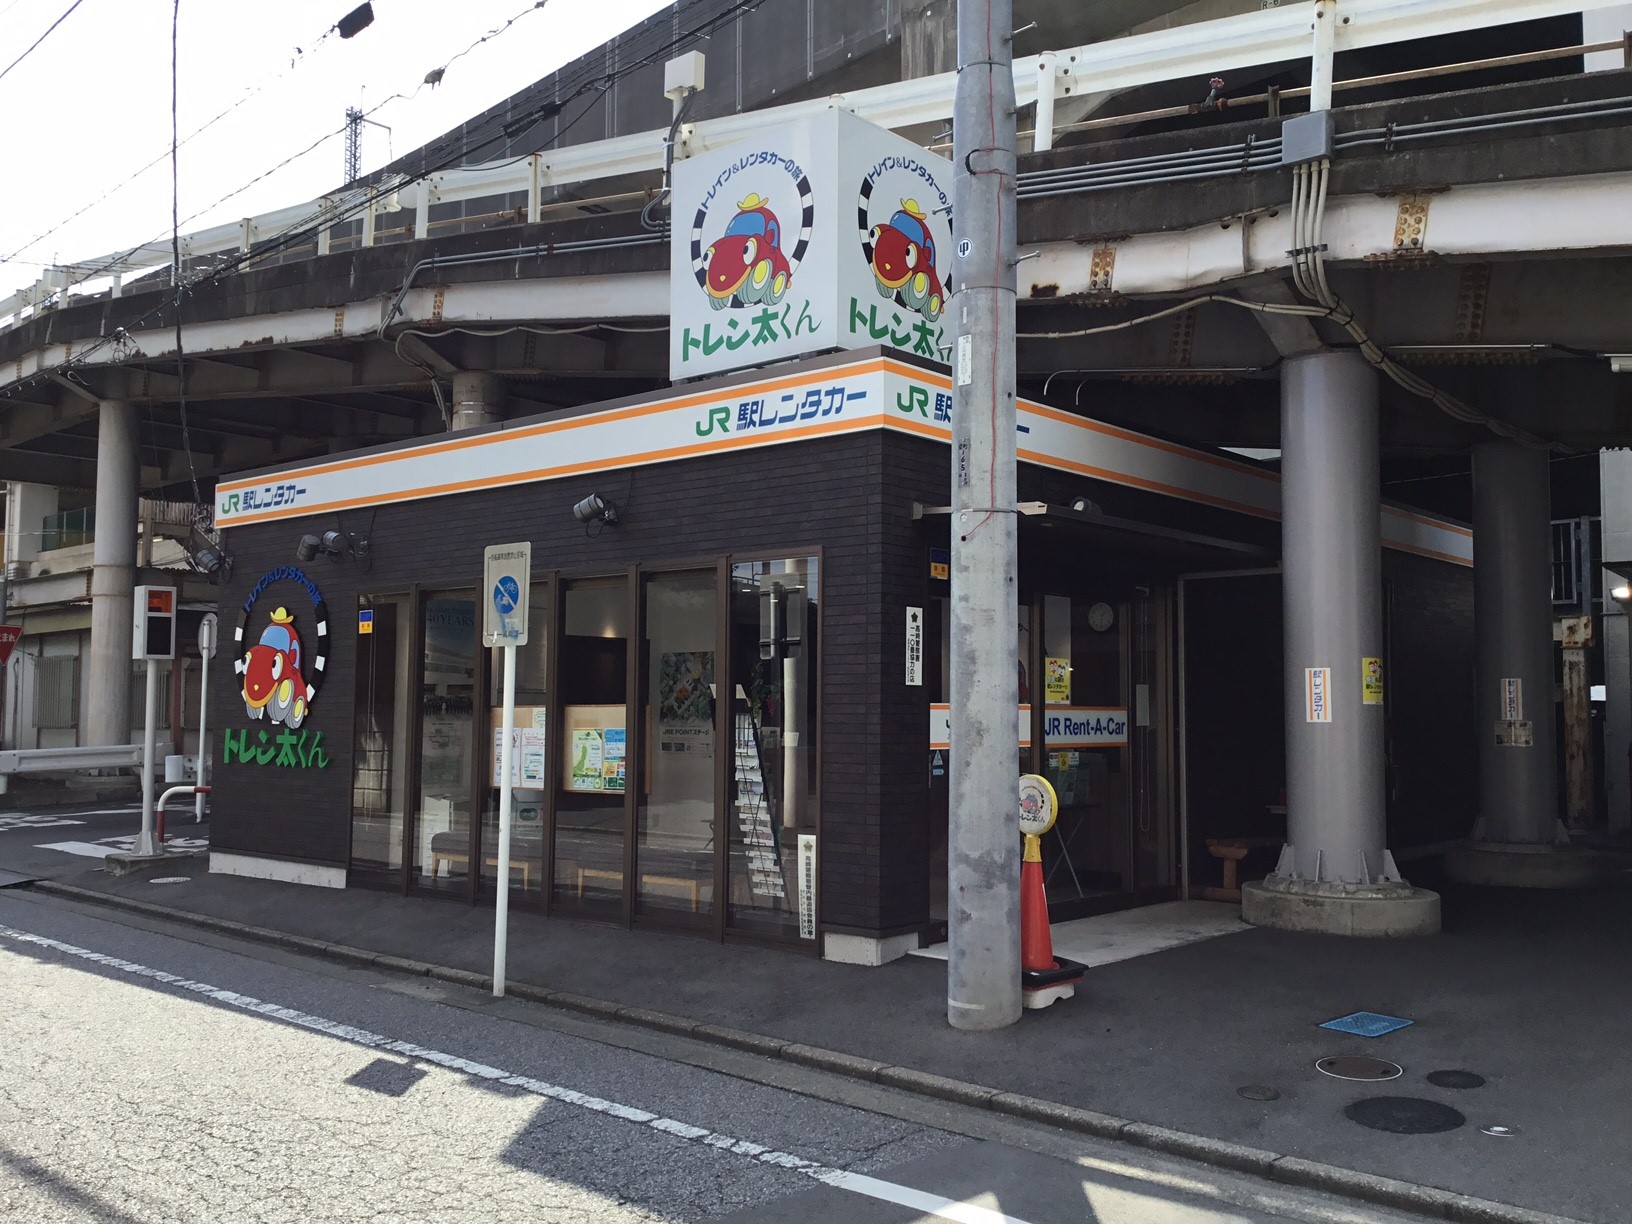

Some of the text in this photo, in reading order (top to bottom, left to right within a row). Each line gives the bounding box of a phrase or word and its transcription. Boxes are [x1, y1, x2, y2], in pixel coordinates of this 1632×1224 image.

[701, 151, 803, 211] トレイン&レンタカーの旅
[682, 299, 822, 362] トレン太くん
[695, 386, 867, 437] JR 駅レンタカー
[896, 385, 929, 418] JR
[222, 484, 307, 515] JR 駅レンタカー
[1045, 717, 1126, 736] JR Rent-A-Car
[223, 727, 331, 769] トレン太くん
